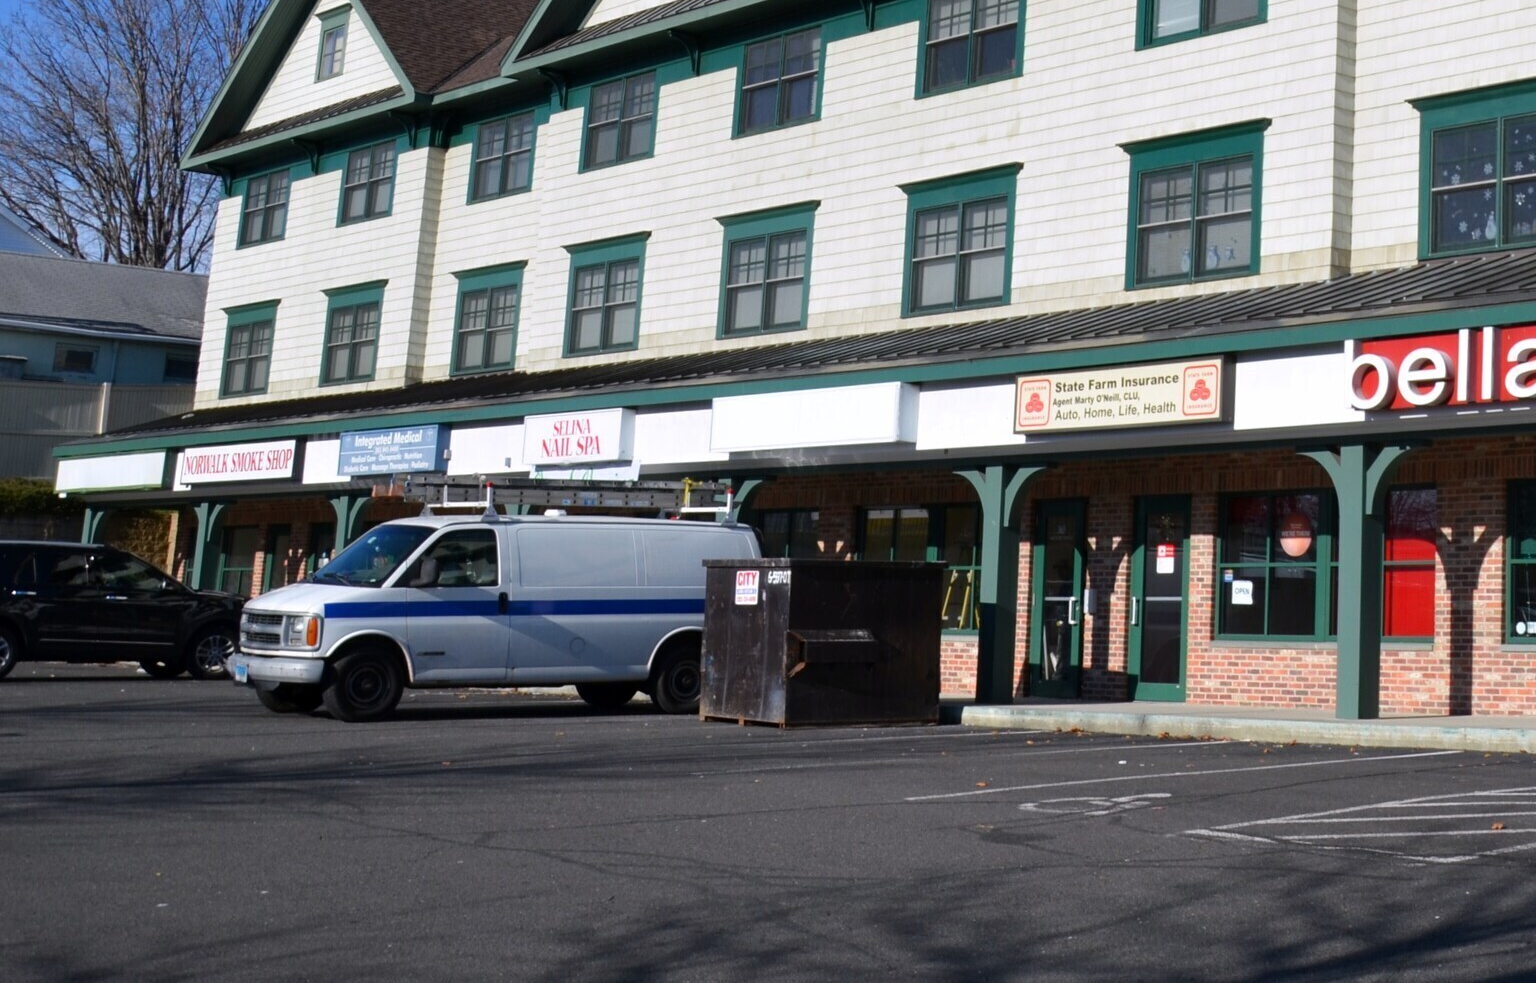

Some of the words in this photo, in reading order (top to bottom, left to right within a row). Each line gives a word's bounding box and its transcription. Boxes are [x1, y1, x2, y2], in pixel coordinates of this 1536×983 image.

[1055, 382, 1085, 393] State
[1088, 379, 1117, 390] Farm
[1121, 375, 1179, 388] Insurance
[1053, 397, 1073, 408] Agent
[1074, 396, 1094, 406] Marty
[1123, 392, 1140, 401] CLU,
[1055, 409, 1081, 421] Auto,
[1084, 407, 1115, 419] Home,
[1119, 404, 1140, 417] Life,
[1143, 401, 1176, 414] Health
[553, 419, 591, 437] SELINA
[354, 432, 393, 449] Integrated
[393, 430, 423, 444] Medical
[541, 437, 573, 457] NAIL
[575, 435, 601, 457] SPA
[184, 453, 229, 475] NORWALK
[230, 451, 265, 473] SMOKE
[266, 448, 293, 470] SHOP
[738, 572, 757, 586] CITY
[1234, 587, 1250, 595] OPEN
